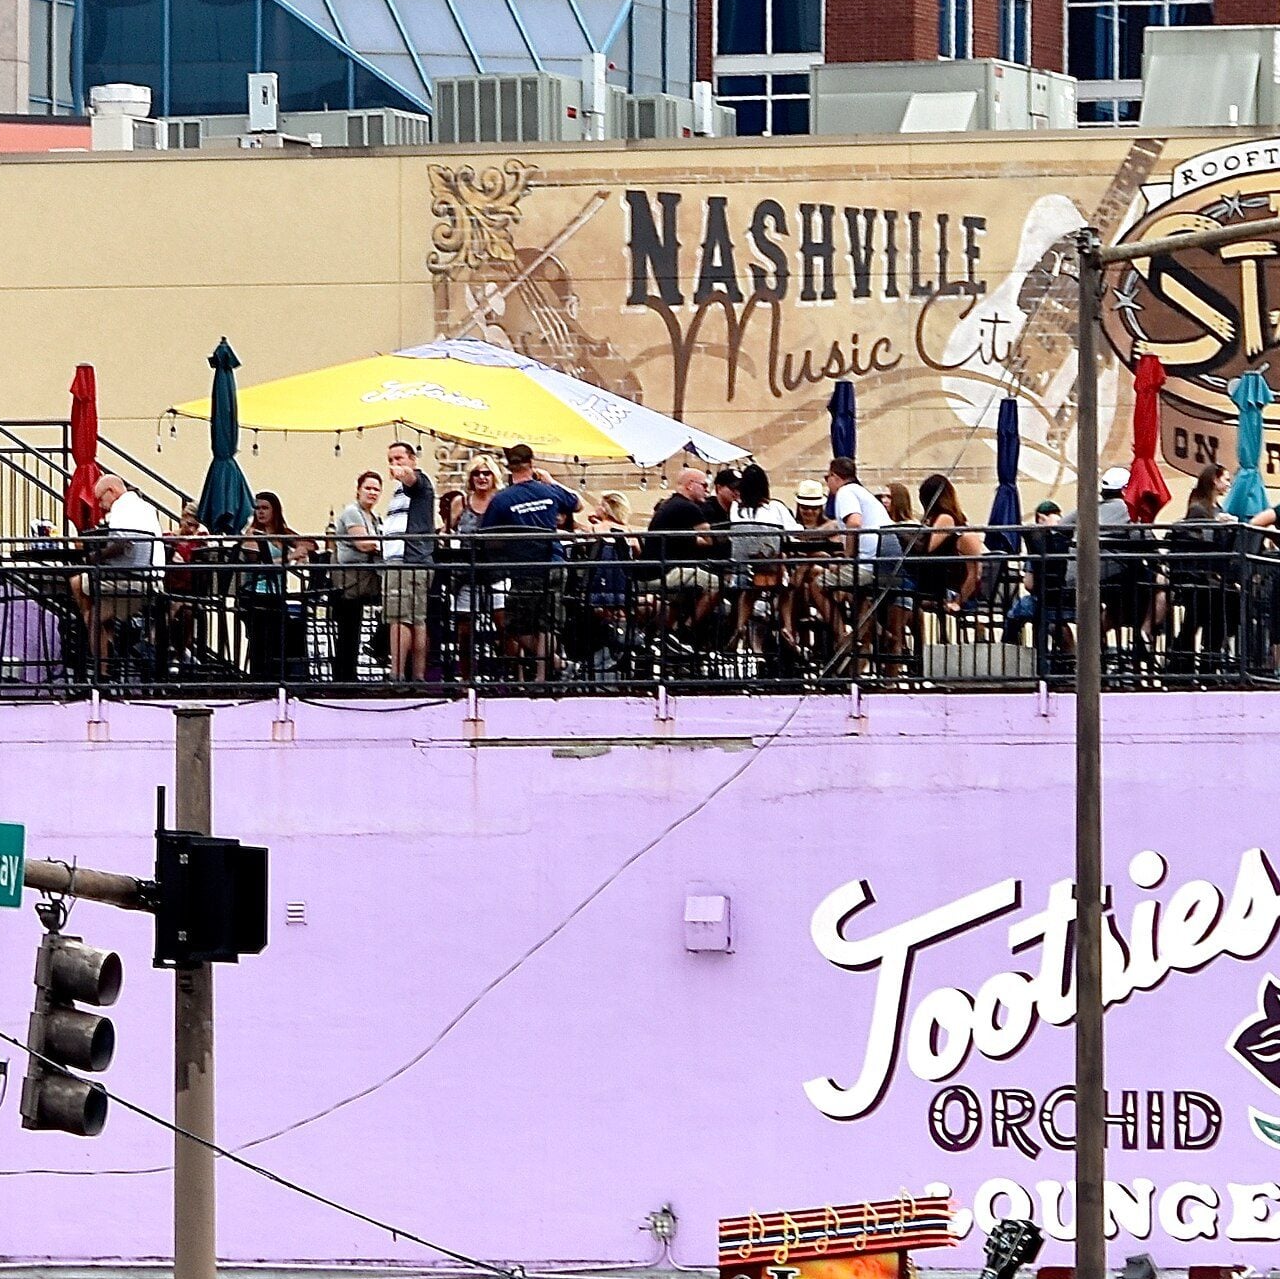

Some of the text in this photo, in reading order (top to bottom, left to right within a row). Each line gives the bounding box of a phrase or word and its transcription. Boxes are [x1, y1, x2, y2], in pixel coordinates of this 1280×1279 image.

[625, 189, 988, 307] NASHVILLE
[629, 280, 1022, 421] Music City
[1174, 426, 1219, 464] ON
[928, 1085, 1223, 1161] ORCHID
